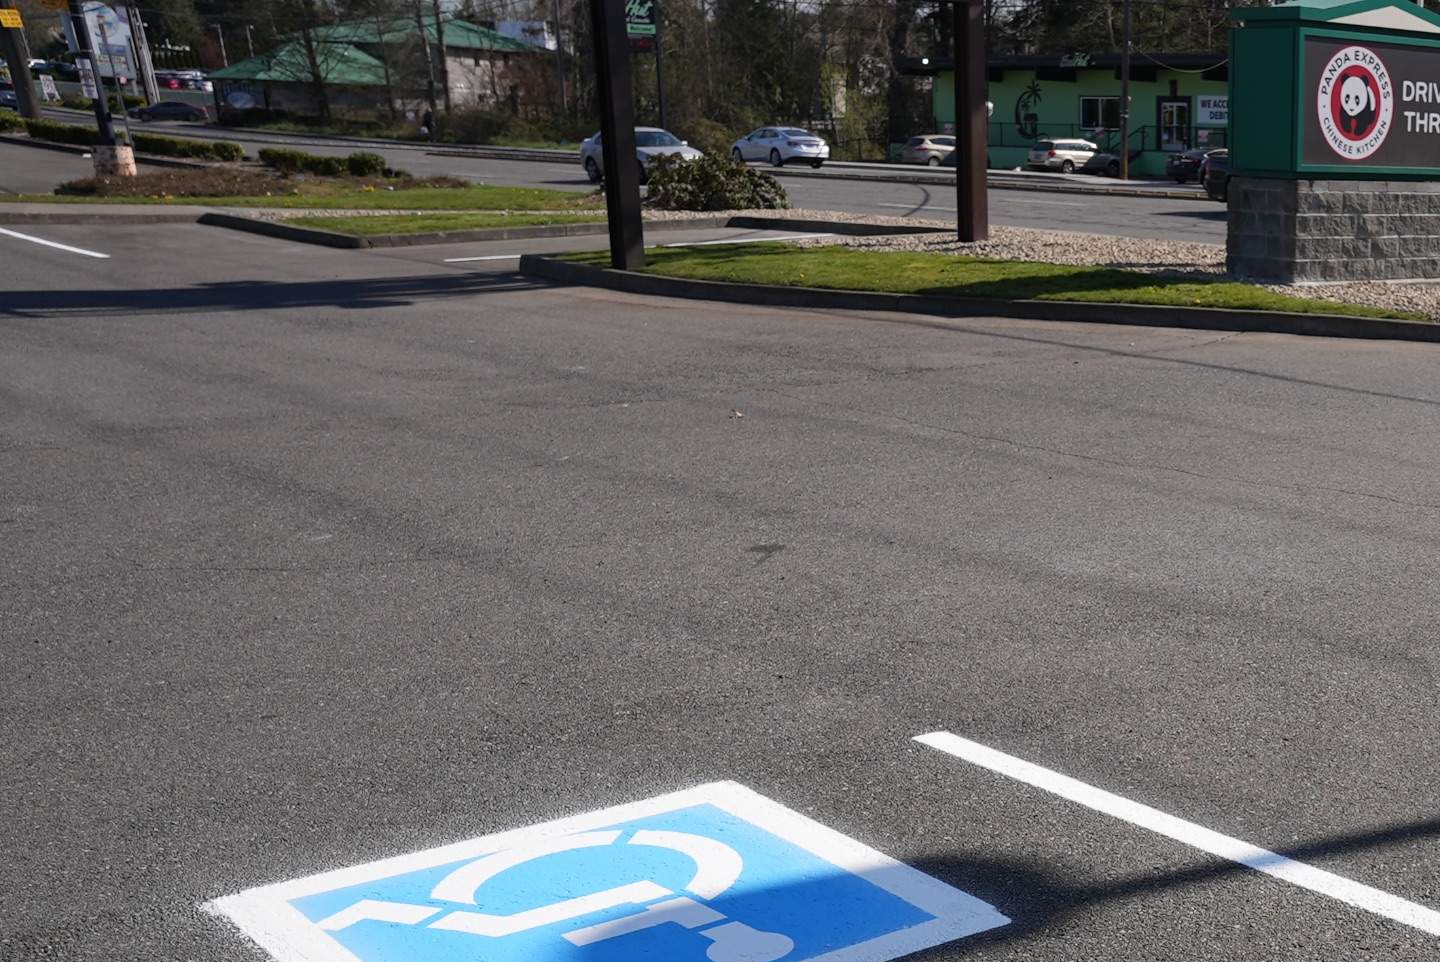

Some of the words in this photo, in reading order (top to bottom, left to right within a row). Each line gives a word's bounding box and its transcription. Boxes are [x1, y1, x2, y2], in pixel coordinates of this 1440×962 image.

[1321, 53, 1351, 96] PANDA
[1354, 50, 1391, 99] EXPRESS
[1324, 117, 1353, 154] CHINESE
[1356, 120, 1387, 154] KITCHEN
